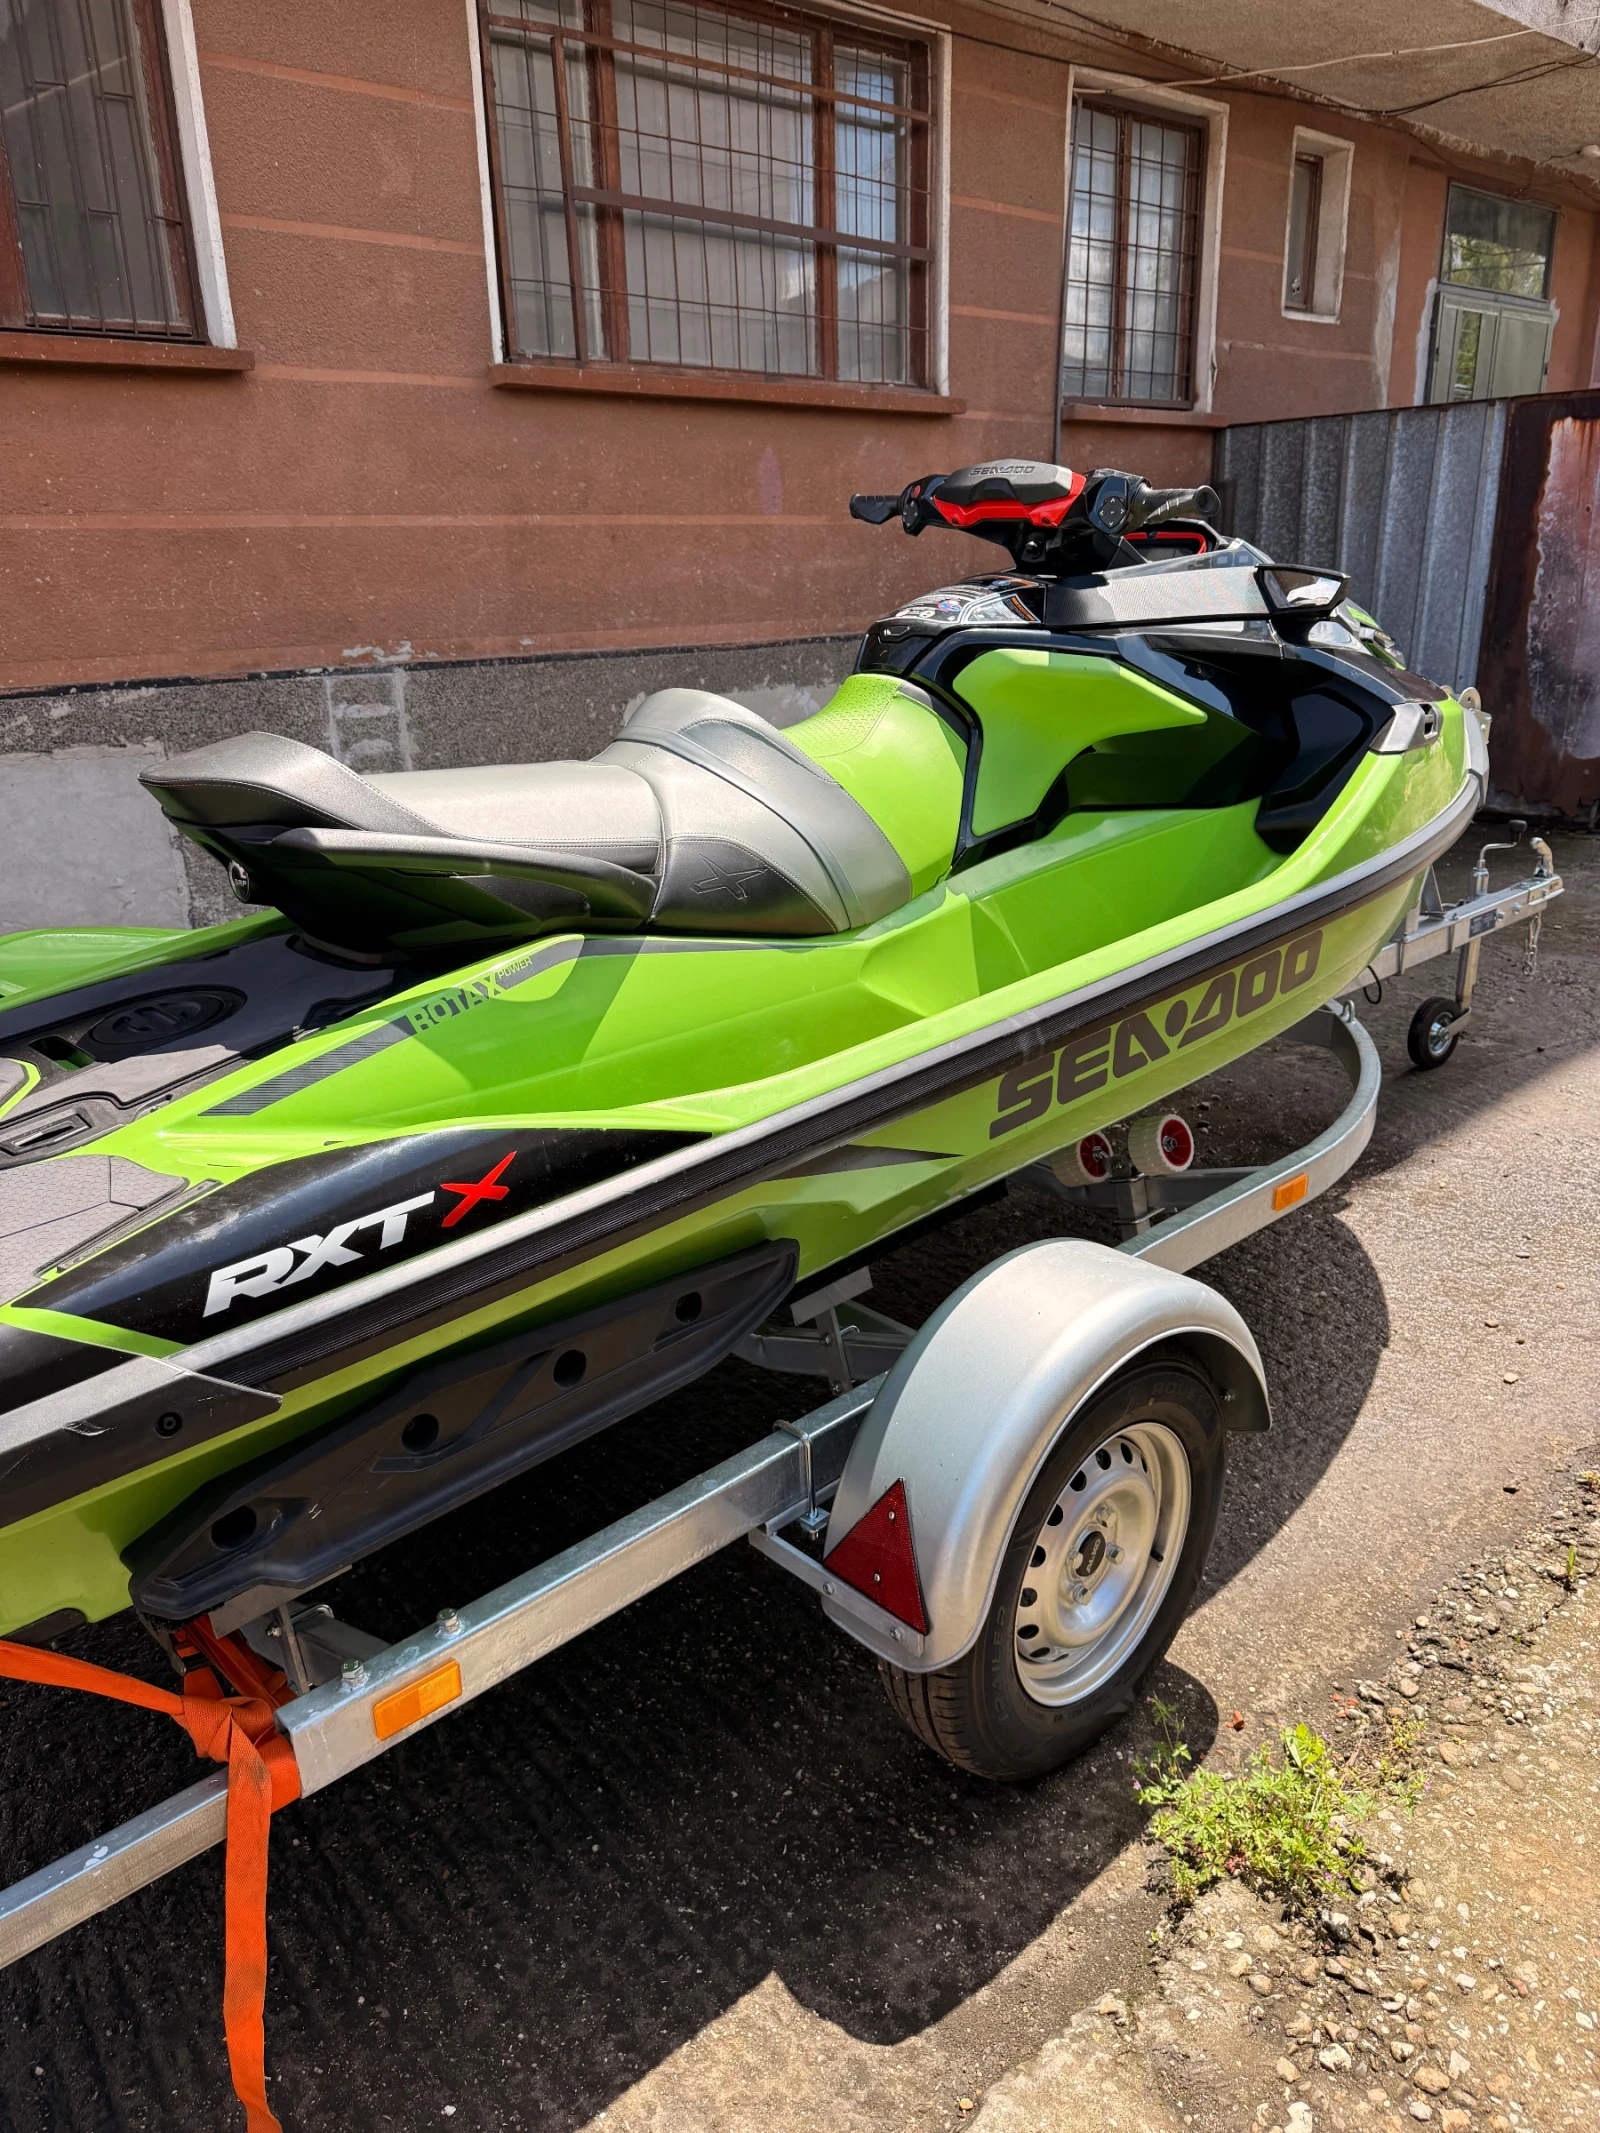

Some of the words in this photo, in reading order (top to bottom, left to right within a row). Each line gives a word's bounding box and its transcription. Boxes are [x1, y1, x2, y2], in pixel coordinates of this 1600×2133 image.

[408, 970, 502, 1033] ROTAX
[497, 956, 533, 980] POWER
[202, 1190, 436, 1319] RXT
[439, 1150, 518, 1228] X
